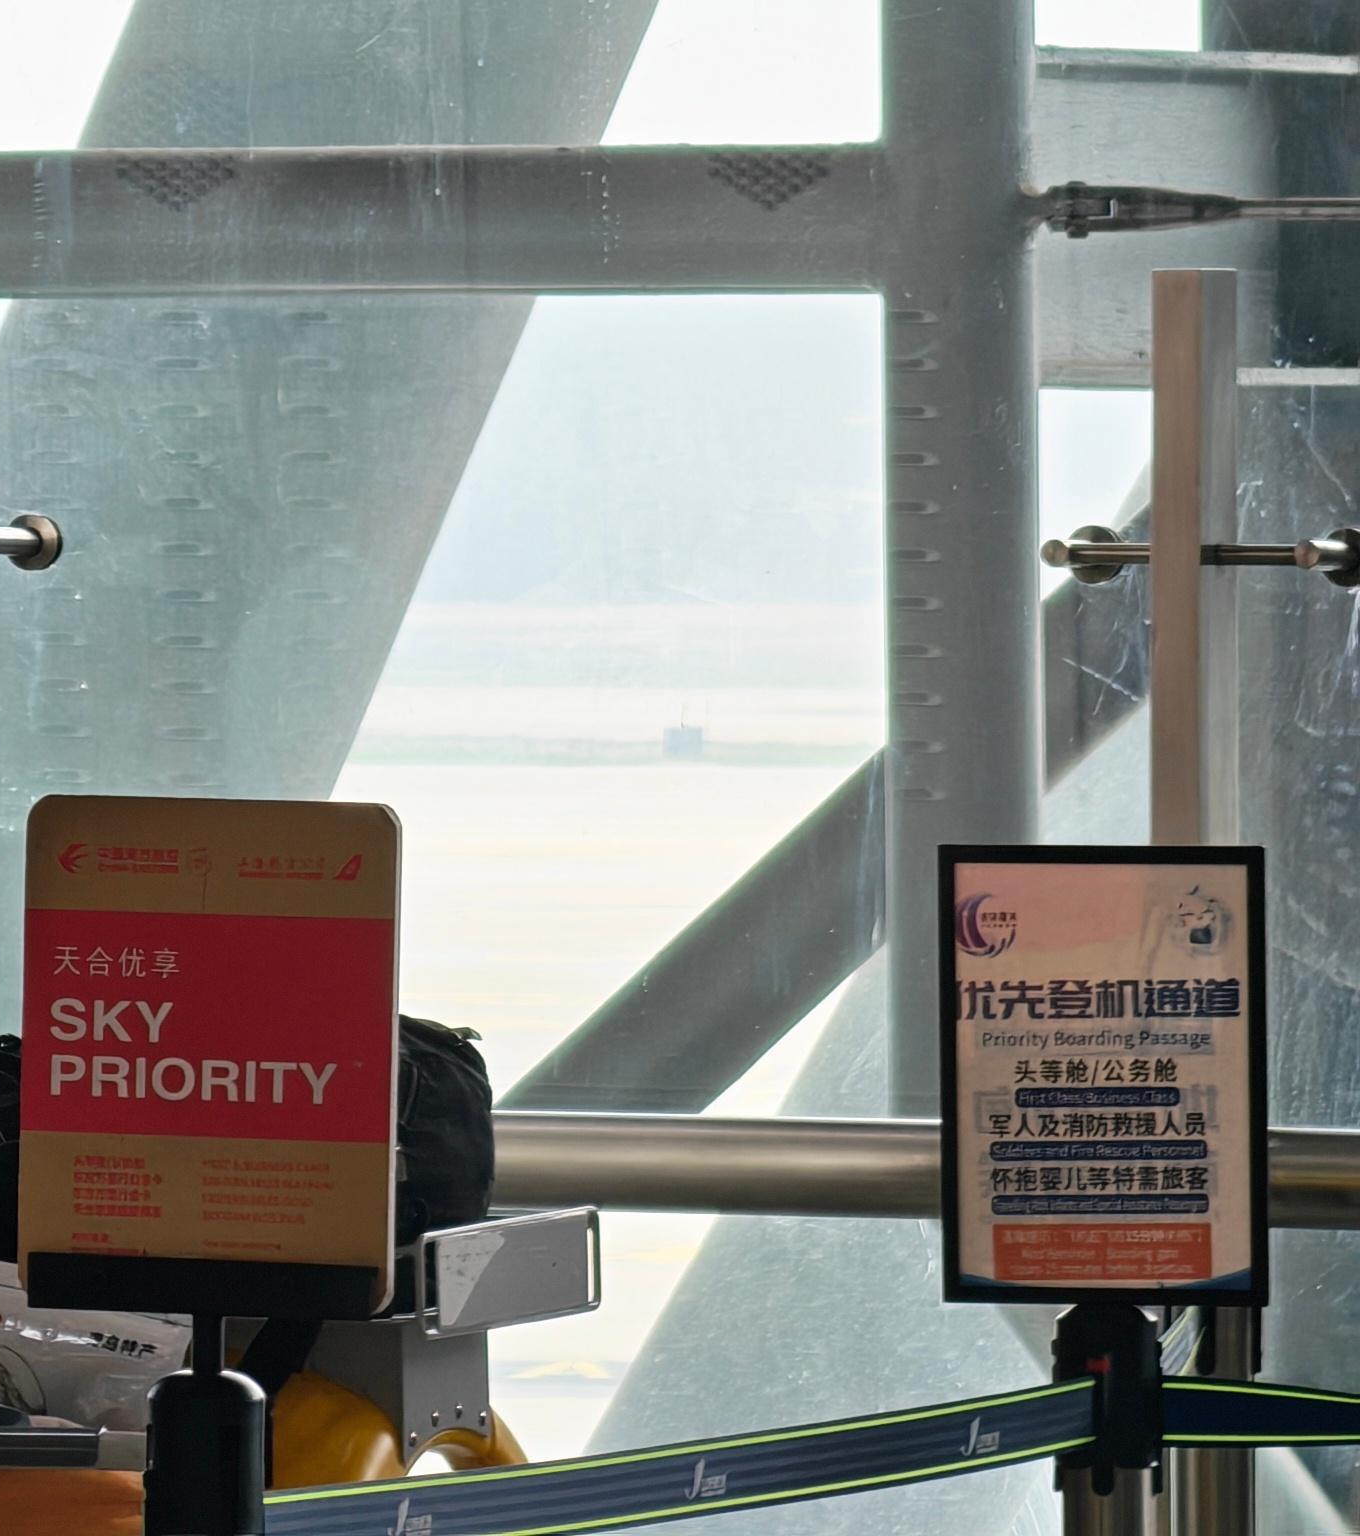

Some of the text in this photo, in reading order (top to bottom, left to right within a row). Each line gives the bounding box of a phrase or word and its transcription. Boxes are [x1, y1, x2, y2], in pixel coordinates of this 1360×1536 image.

[52, 946, 180, 978] 天合优享
[954, 978, 1241, 1020] 优先登机通道
[49, 998, 174, 1043] SKY
[982, 1030, 1211, 1049] Priority Boarding Passage
[49, 1055, 337, 1105] PRIORITY
[1014, 1058, 1178, 1086] 头等舱/公务舱
[989, 1112, 1206, 1138] 军人及消防救援人员
[990, 1166, 1210, 1192] 怀抱婴儿等特需旅客
